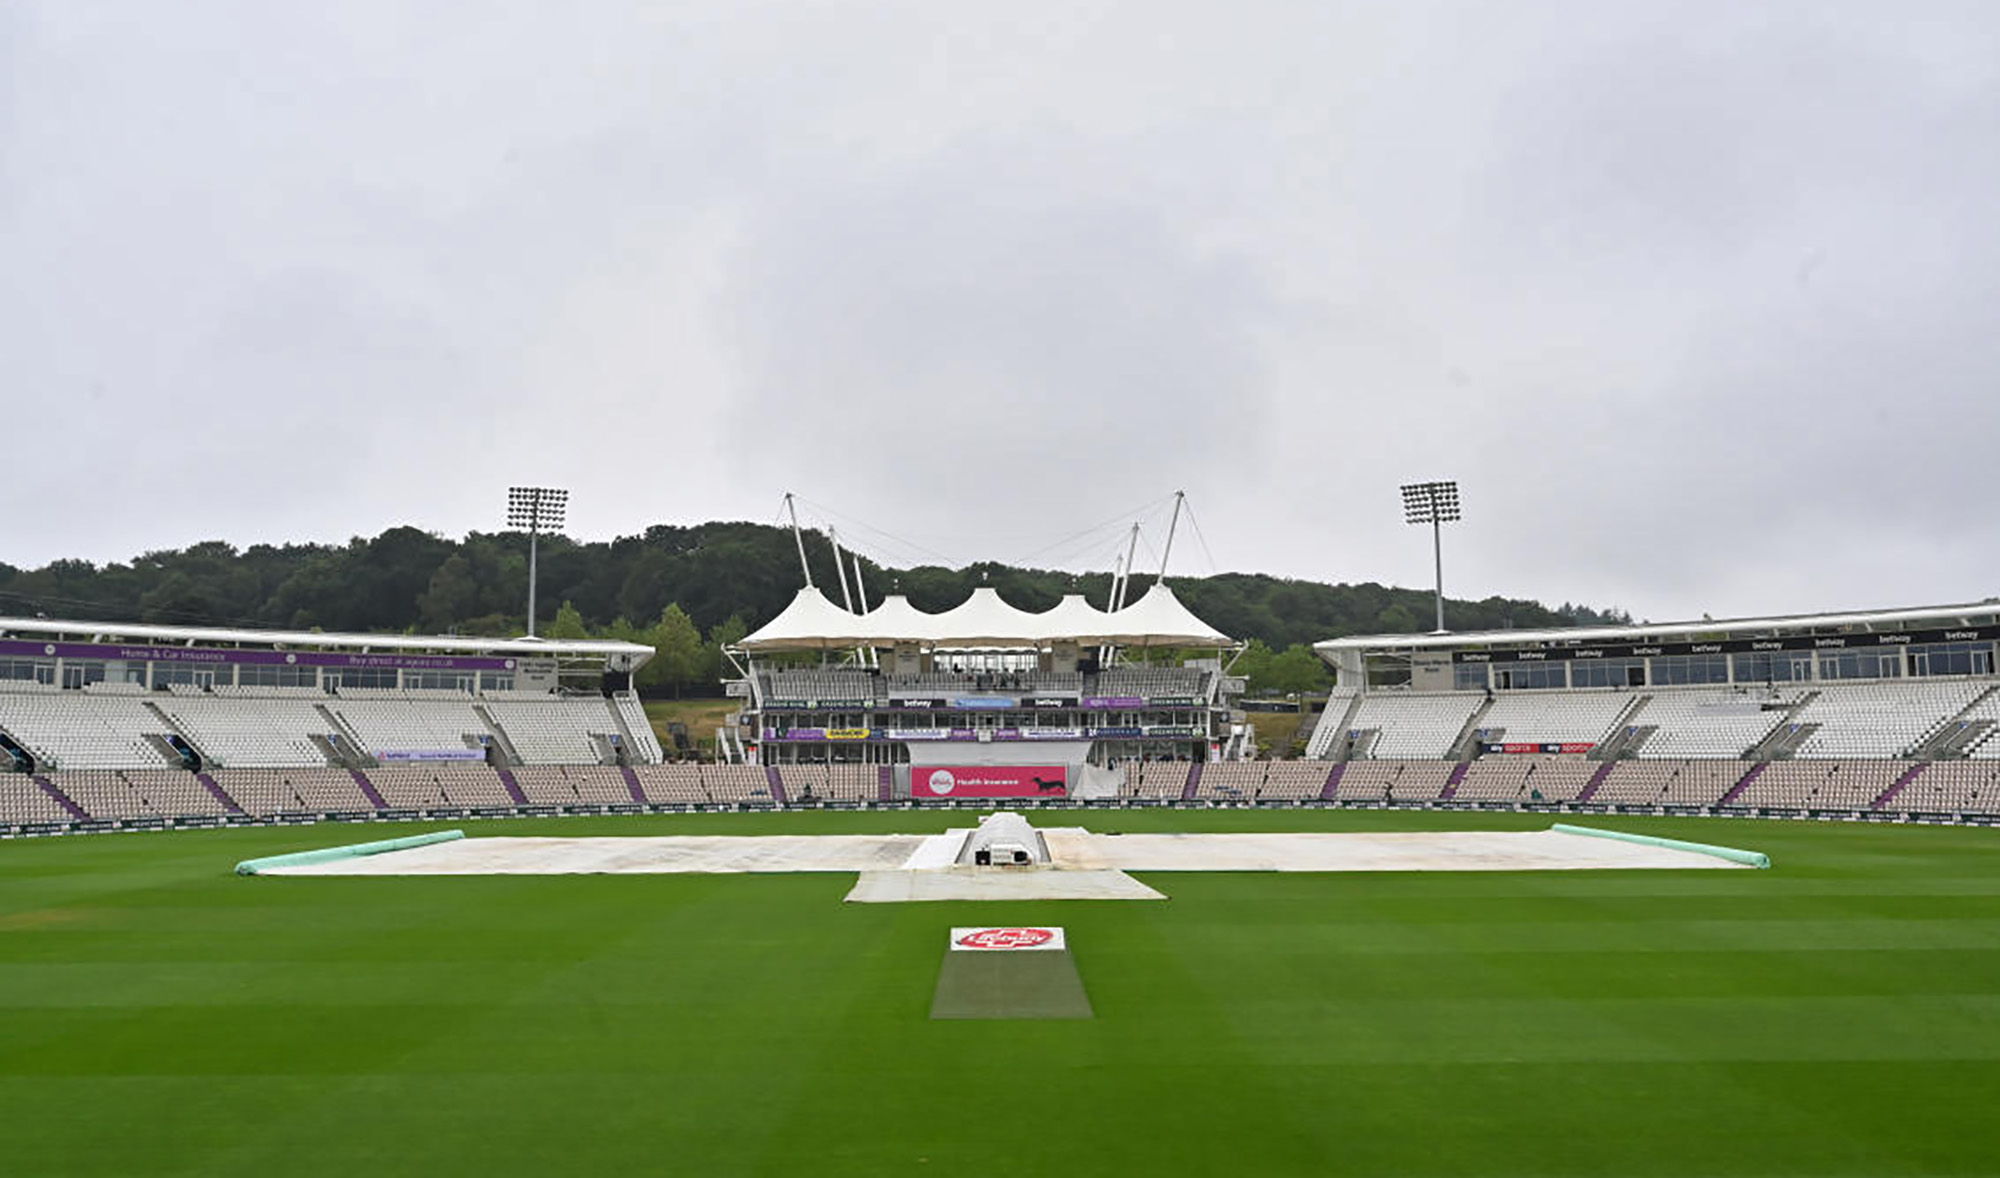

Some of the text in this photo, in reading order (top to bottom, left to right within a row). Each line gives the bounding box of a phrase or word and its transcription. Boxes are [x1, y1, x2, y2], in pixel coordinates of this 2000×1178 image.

[1879, 635, 1911, 644] betway
[1945, 631, 1977, 640] betway
[1752, 642, 1783, 651] betway
[1815, 639, 1846, 648] betway
[1633, 647, 1662, 656] betway
[1691, 645, 1722, 653] betway
[1462, 653, 1491, 662] betway
[1518, 651, 1547, 661] betway
[1575, 650, 1604, 658] betway
[904, 700, 932, 708] betway
[1035, 699, 1063, 708] betway
